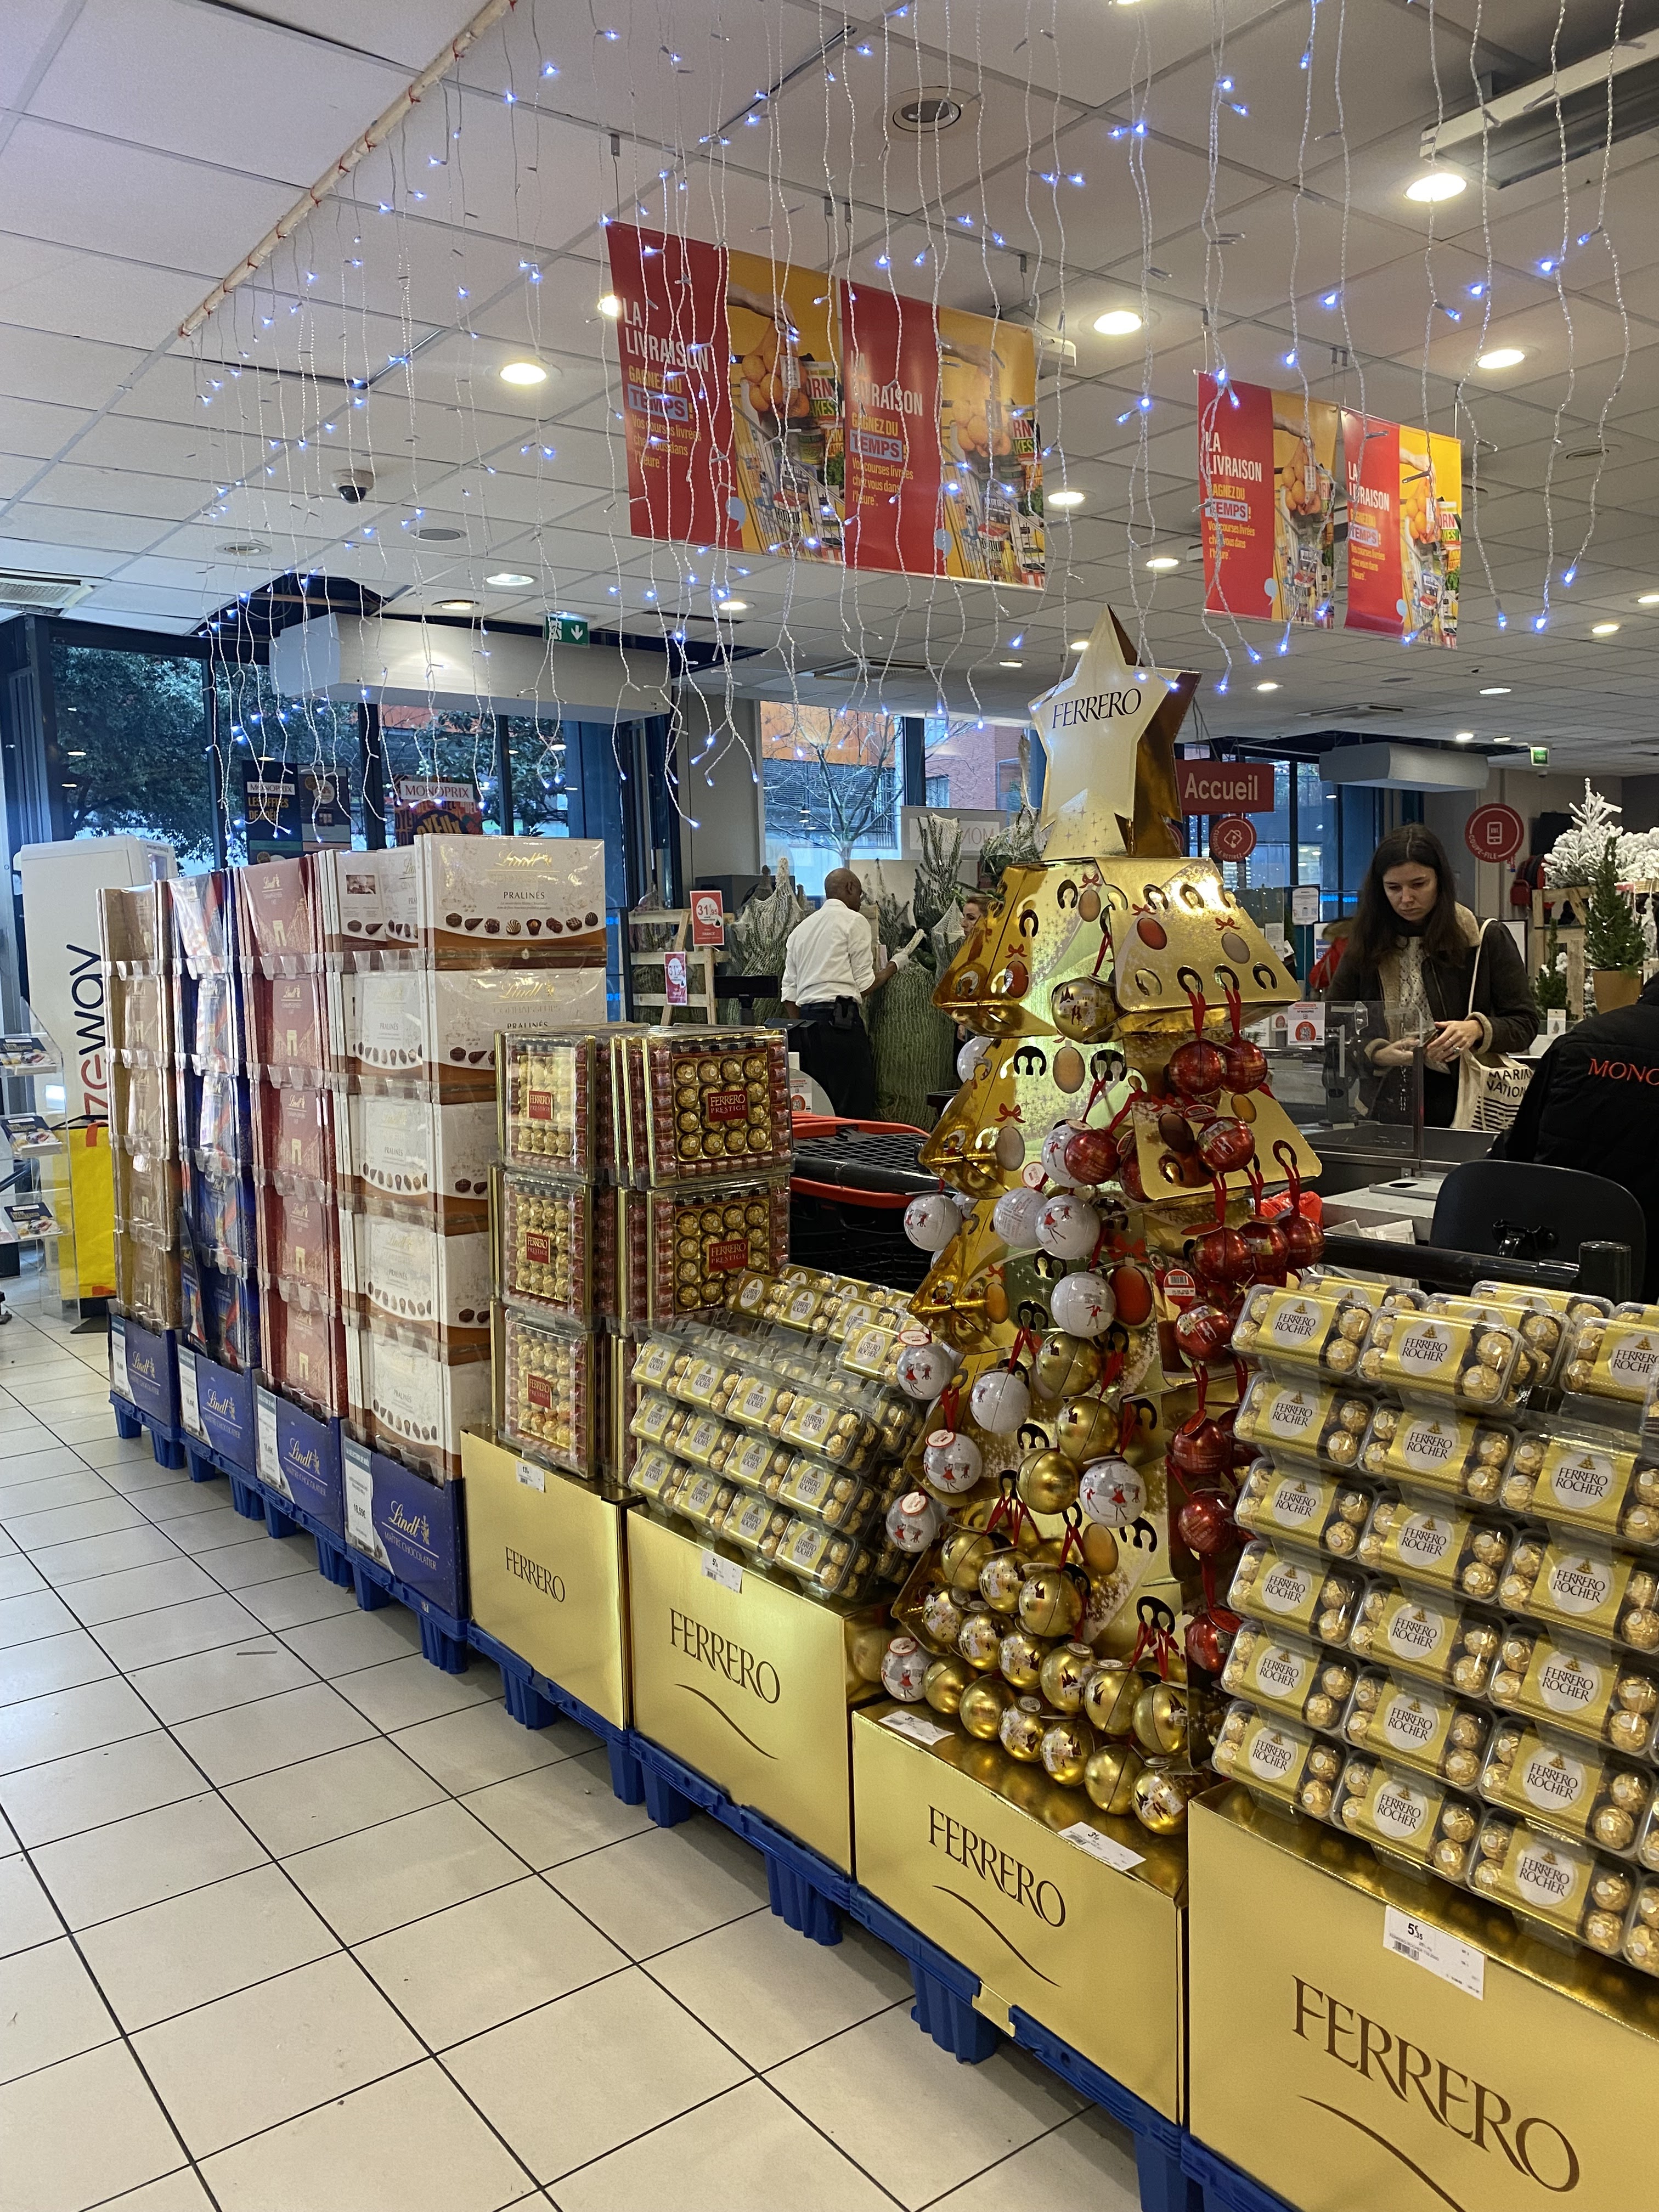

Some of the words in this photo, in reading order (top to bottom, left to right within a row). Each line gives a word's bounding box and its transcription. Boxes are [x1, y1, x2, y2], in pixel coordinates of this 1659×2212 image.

[623, 297, 643, 328] LA
[625, 327, 709, 372] LIVRAISON
[629, 365, 665, 390] GAGNE
[646, 420, 675, 437] courss
[885, 420, 899, 437] DU
[634, 432, 651, 449] che
[851, 433, 900, 458] TEMPS
[1206, 431, 1221, 453] LA
[1348, 461, 1358, 482] LA
[853, 474, 867, 488] chz
[867, 479, 883, 491] vous
[1207, 483, 1235, 499] AGNEZ
[1052, 688, 1142, 729] FERRERO
[250, 783, 292, 793] MONOPRIX
[405, 785, 469, 799] MONOPRIX
[1184, 772, 1258, 801] Accueil
[1469, 834, 1497, 859] COUPE-FILE
[503, 890, 545, 900] PRALINÉS
[498, 981, 544, 998] Lindt
[529, 1094, 550, 1105] FERRERO
[710, 1094, 746, 1107] FERRERO
[710, 1104, 746, 1114] PRESTIGE
[527, 1235, 548, 1249] FERRERO
[711, 1242, 746, 1256] FERRERO
[527, 1246, 548, 1256] PRESTIGE
[711, 1252, 747, 1265] PRESTIGE
[742, 1293, 757, 1301] ROCHER
[794, 1300, 811, 1310] FERRERO
[792, 1305, 808, 1314] ROCHER
[1274, 1321, 1312, 1336] ROCHER
[1278, 1312, 1316, 1328] FERRERO
[859, 1346, 877, 1358] ROCHER
[1404, 1337, 1447, 1353] FERRERO
[132, 1351, 151, 1374] Lindt
[651, 1357, 666, 1366] FERRERO
[1402, 1347, 1443, 1362] ROCHER
[648, 1363, 663, 1372] ROCHER
[1612, 1359, 1655, 1373] ROCHE
[529, 1378, 549, 1393] FERRERO
[695, 1379, 710, 1389] ROCHER
[698, 1373, 713, 1383] FERRERO
[207, 1389, 228, 1415] Lindt
[745, 1399, 763, 1408] ROCHER
[749, 1393, 766, 1403] FERRERO
[1275, 1402, 1313, 1418] FERRERO
[802, 1420, 821, 1432] ROCHER
[805, 1414, 825, 1425] FERRERO
[1272, 1411, 1308, 1427] ROCHER
[692, 1437, 709, 1447] ROCHER
[696, 1431, 712, 1441] FERRERO
[1409, 1431, 1453, 1449] FERRERO
[289, 1437, 313, 1469] Lindt
[745, 1452, 762, 1463] FERRERO
[1406, 1441, 1448, 1459] ROCHER
[647, 1465, 663, 1475] FERRERO
[741, 1458, 759, 1470] ROCHER
[802, 1476, 821, 1488] FERRERO
[1558, 1467, 1608, 1487] FERRERO
[693, 1487, 710, 1498] FERRERO
[798, 1483, 818, 1496] ROCHER
[1555, 1477, 1603, 1498] ROCHER
[690, 1494, 706, 1505] ROCHER
[1279, 1489, 1317, 1508] FERRERO
[1274, 1499, 1312, 1517] ROCHER
[388, 1500, 420, 1537] Lindt
[741, 1518, 758, 1531] ROCHER
[743, 1511, 761, 1524] FERRERO
[1404, 1526, 1447, 1546] FERRERO
[795, 1545, 813, 1559] ROCHER
[798, 1539, 816, 1552] FERRERO
[1401, 1536, 1443, 1556] ROCHER
[401, 1542, 437, 1571] CHOCOLATIER
[505, 1546, 566, 1603] FERRERO
[1556, 1569, 1605, 1592] FERRERO
[1268, 1575, 1306, 1593] FERRERO
[1553, 1579, 1601, 1604] ROCHER
[1265, 1584, 1301, 1604] ROCHER
[1395, 1617, 1437, 1638] FERRERO
[1391, 1627, 1433, 1649] ROCHER
[669, 1607, 781, 1704] FERRERO
[1262, 1658, 1299, 1678] FERRERO
[1259, 1667, 1295, 1688] ROCHER
[1545, 1666, 1594, 1690] FERRERO
[1542, 1676, 1589, 1702] ROCHER
[1391, 1708, 1433, 1729] FERRERO
[1387, 1718, 1429, 1741] ROCHER
[1255, 1739, 1292, 1761] FERRERO
[1252, 1748, 1287, 1771] ROCHER
[1530, 1762, 1578, 1788] FERRERO
[1526, 1773, 1573, 1801] ROCHER
[1380, 1794, 1421, 1816] FERRERO
[1376, 1804, 1417, 1830] ROCHER
[928, 1804, 1066, 1928] FERRERO
[1522, 1857, 1570, 1884] FERRERO
[1519, 1867, 1565, 1897] ROCHER
[1291, 1974, 1580, 2193] FERRERO
